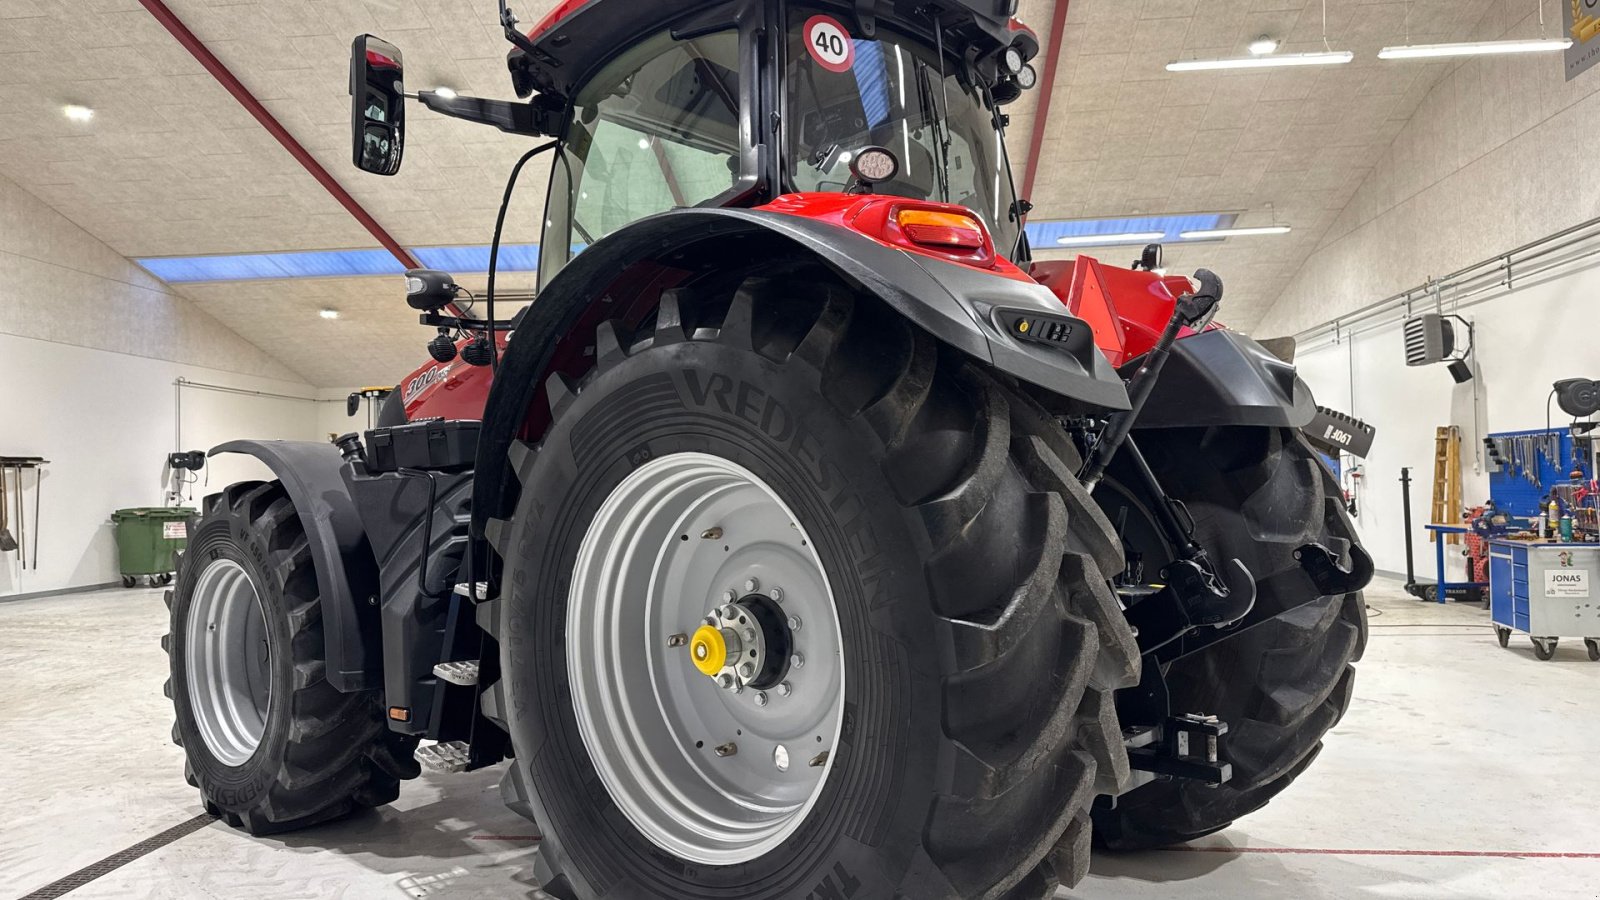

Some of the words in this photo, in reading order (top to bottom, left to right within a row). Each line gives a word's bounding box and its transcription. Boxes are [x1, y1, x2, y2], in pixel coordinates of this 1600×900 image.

[815, 31, 843, 56] 40
[406, 366, 437, 398] 300
[1331, 429, 1352, 445] L90F
[683, 369, 903, 612] VREDESTEIN
